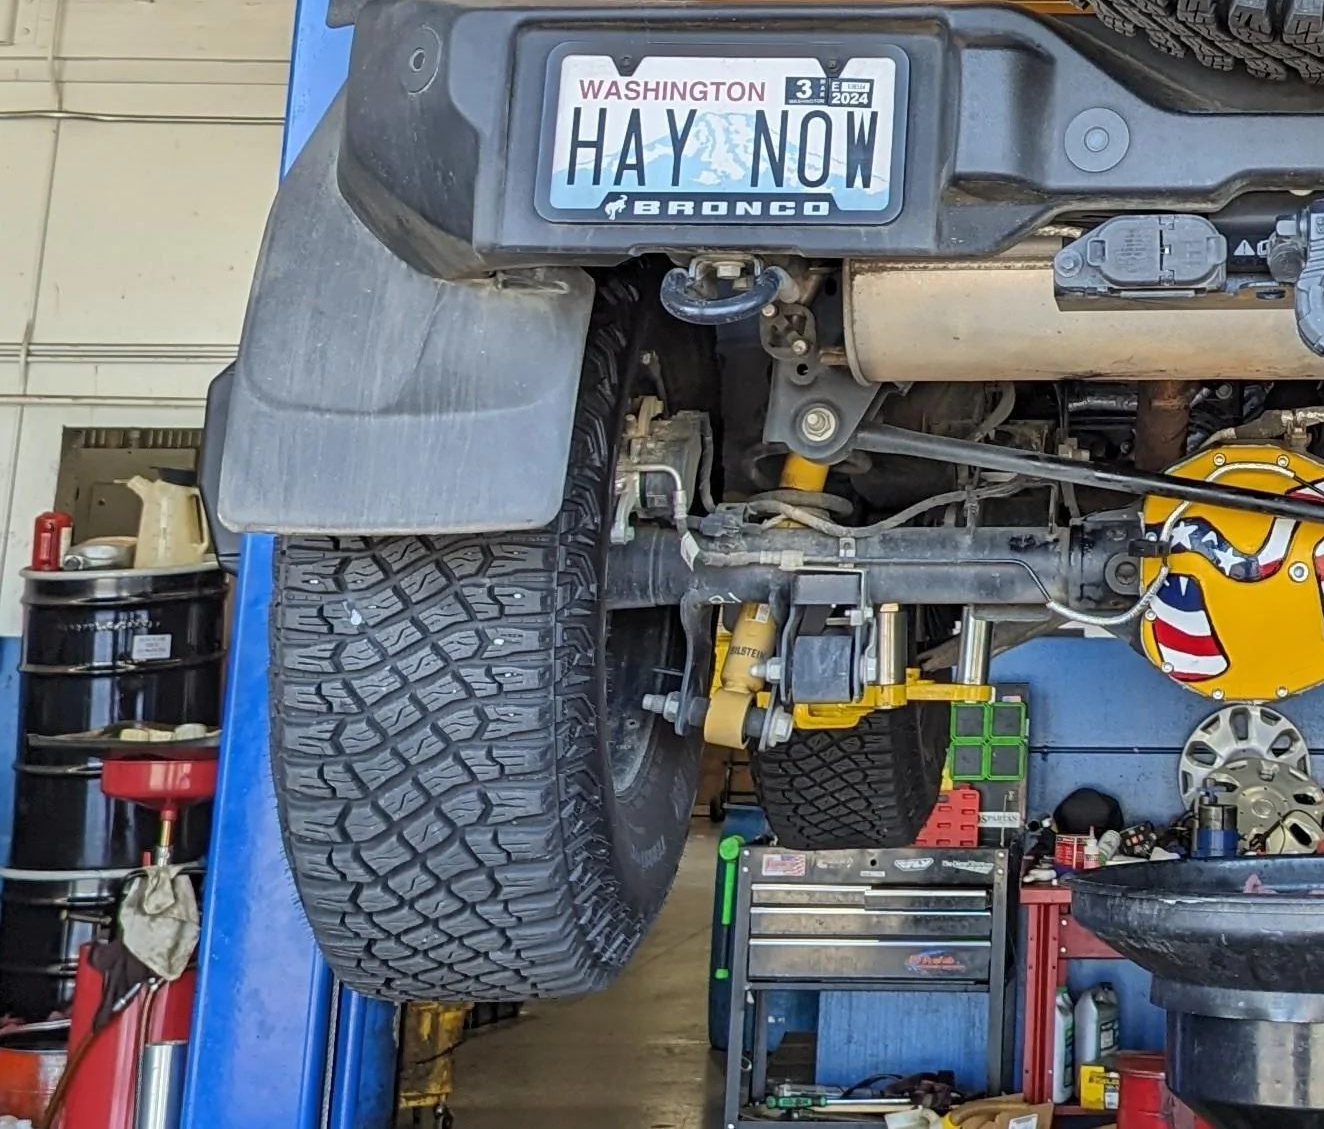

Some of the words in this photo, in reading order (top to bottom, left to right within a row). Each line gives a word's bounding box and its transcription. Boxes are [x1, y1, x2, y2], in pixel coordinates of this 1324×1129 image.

[579, 79, 766, 101] WASHINGTON
[796, 79, 812, 99] 3
[831, 92, 868, 105] 2024
[566, 107, 698, 186] HAY
[750, 109, 878, 189] NOW
[633, 200, 830, 216] BRONCO
